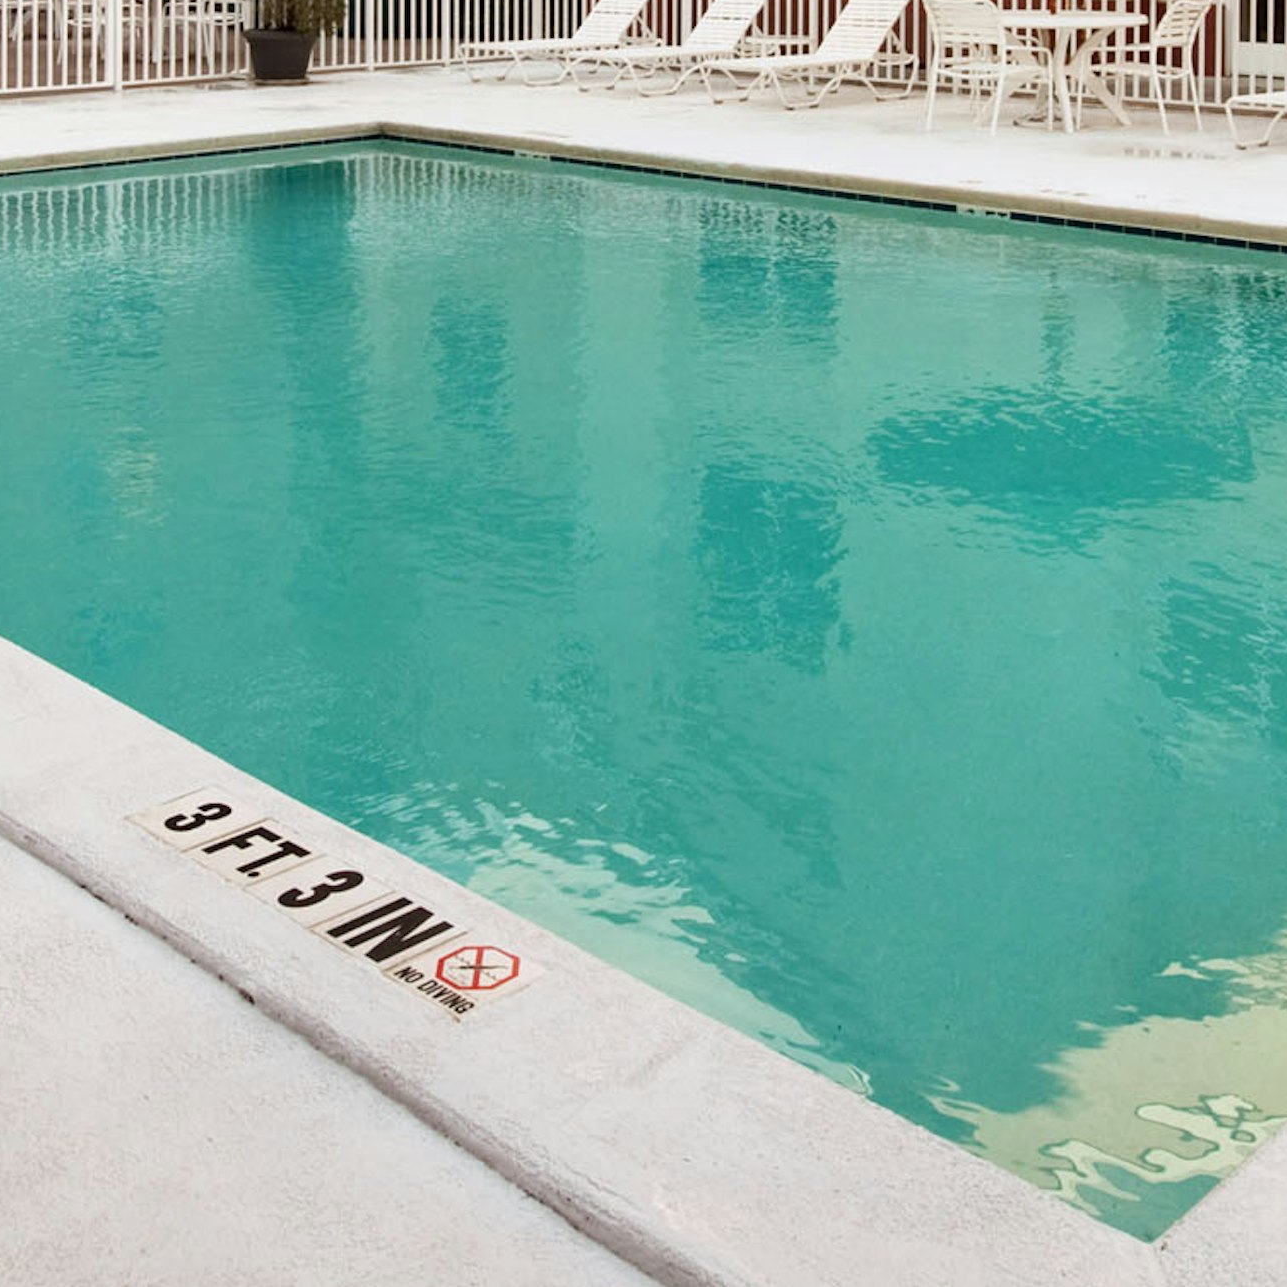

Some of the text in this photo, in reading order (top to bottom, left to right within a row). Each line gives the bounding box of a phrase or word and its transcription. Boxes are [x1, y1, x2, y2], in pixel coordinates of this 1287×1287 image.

[163, 802, 233, 833] 3
[276, 869, 365, 909] 3
[325, 897, 455, 964] IN
[393, 965, 476, 1015] NO DIVING
